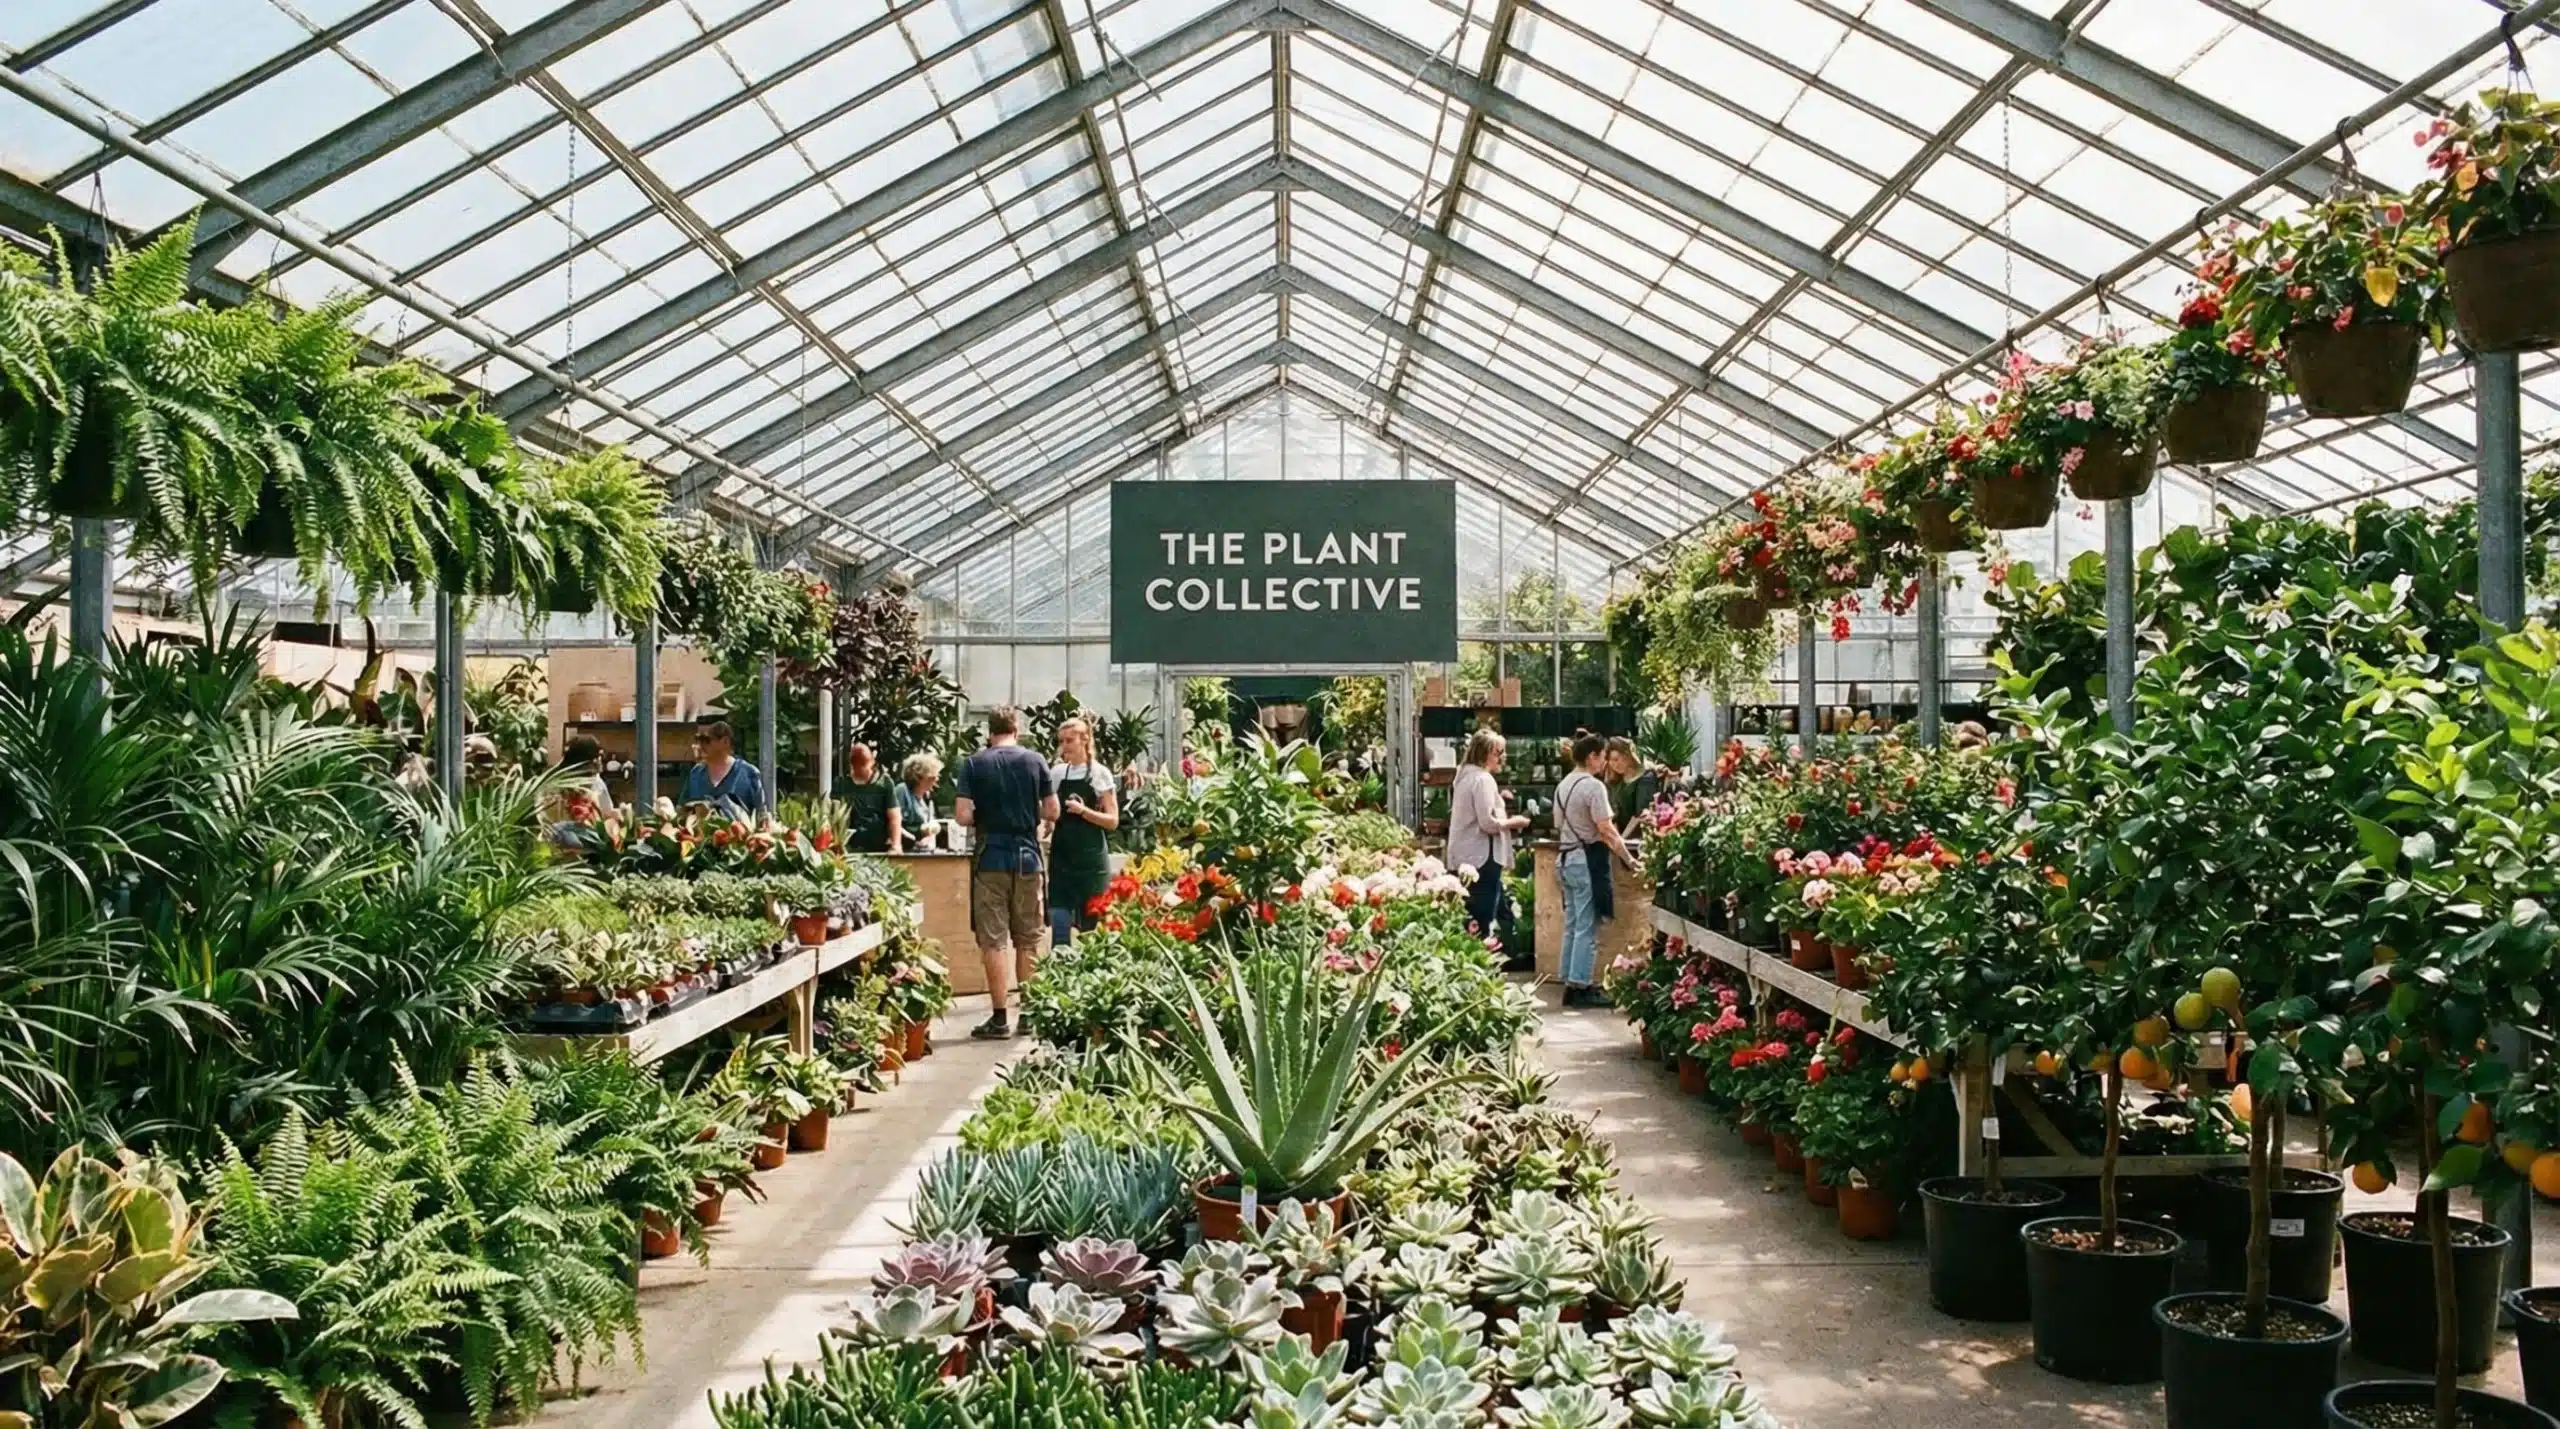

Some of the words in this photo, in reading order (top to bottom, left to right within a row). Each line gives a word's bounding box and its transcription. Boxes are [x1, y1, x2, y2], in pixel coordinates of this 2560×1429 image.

[1160, 533, 1245, 565] THE
[1264, 532, 1406, 565] PLANT
[1145, 578, 1421, 611] COLLECTIVE
